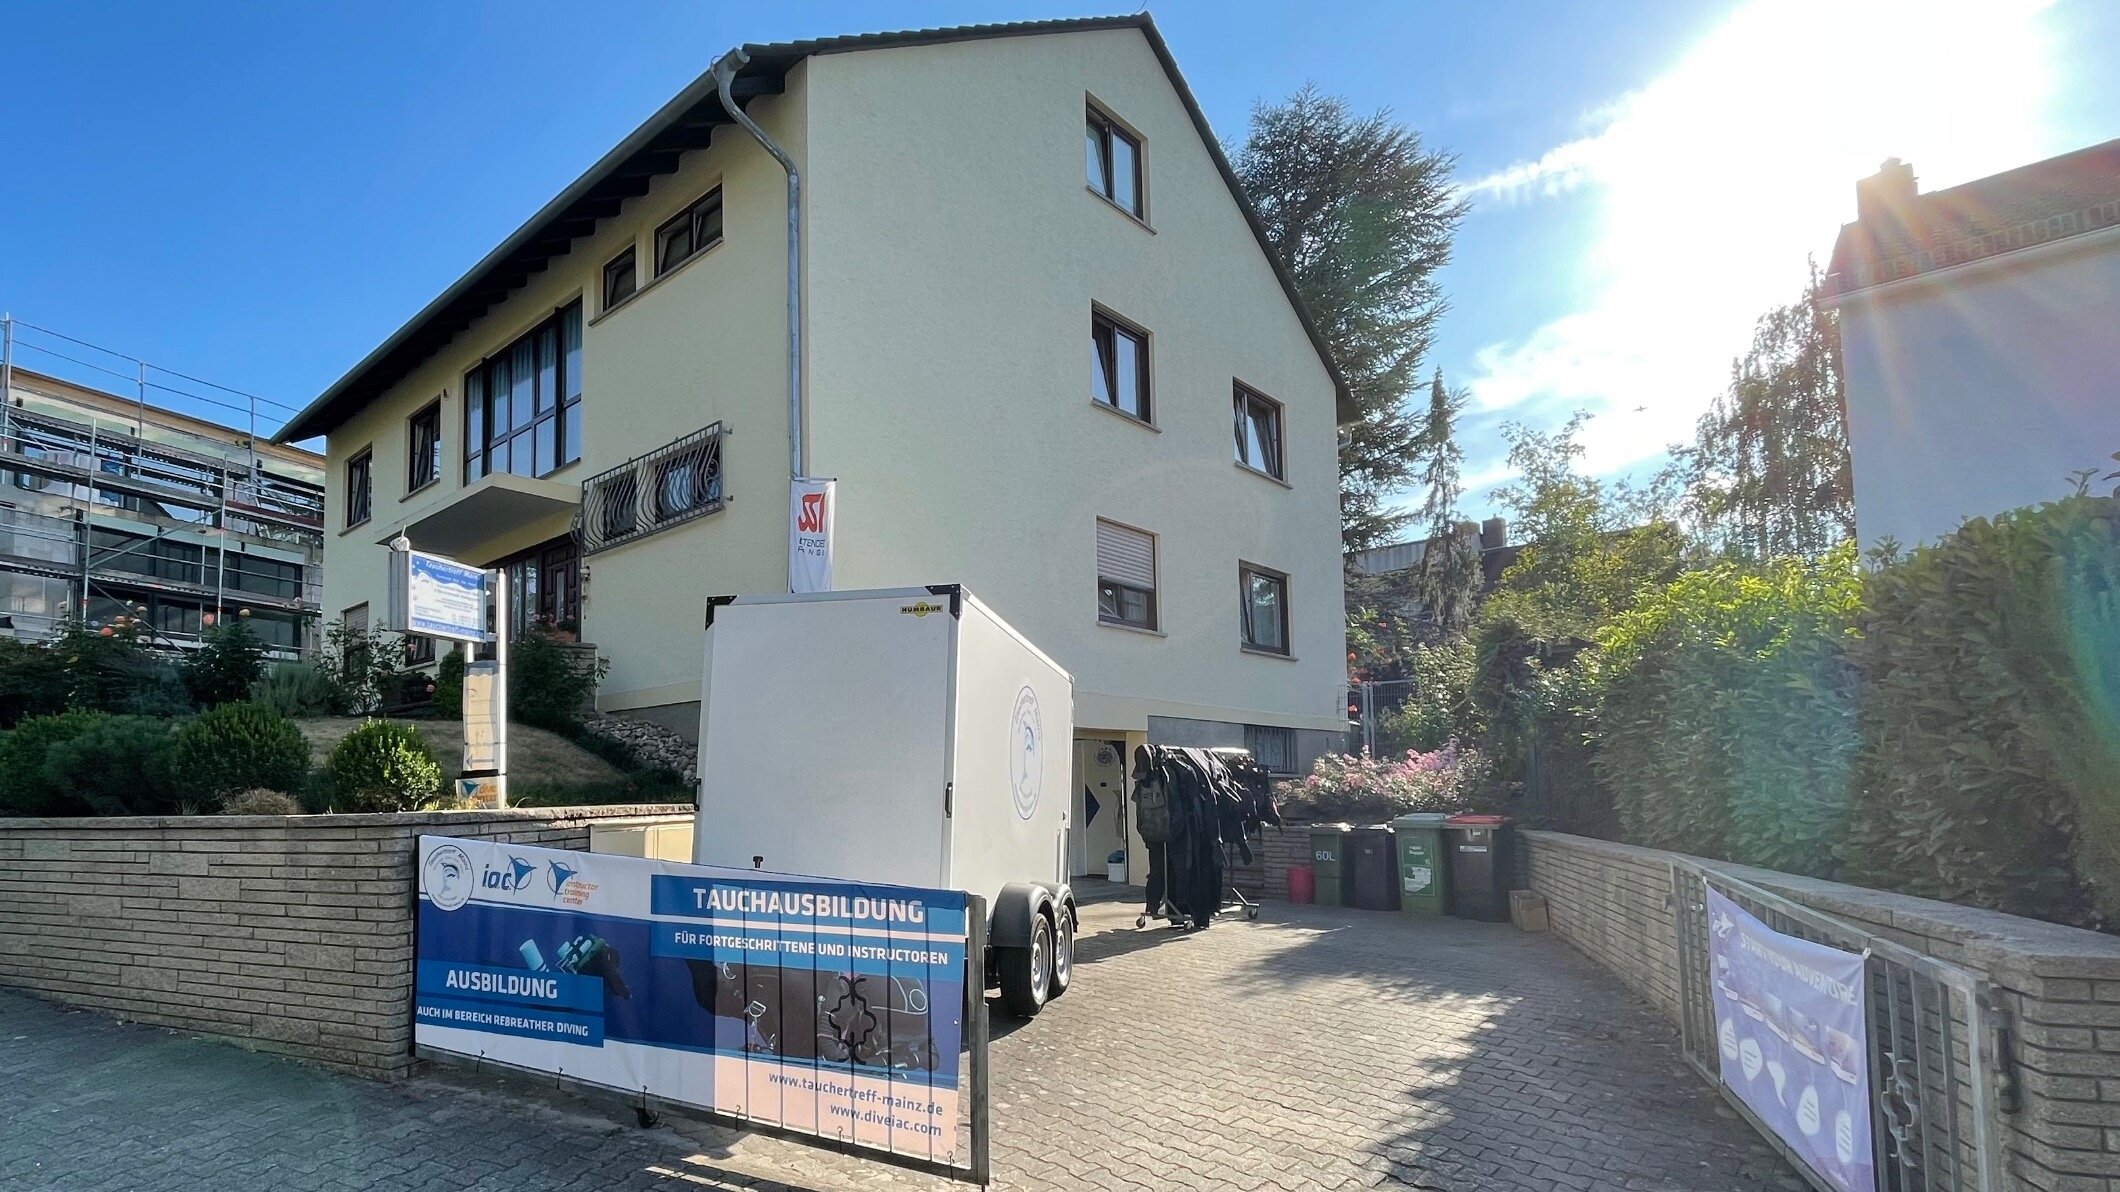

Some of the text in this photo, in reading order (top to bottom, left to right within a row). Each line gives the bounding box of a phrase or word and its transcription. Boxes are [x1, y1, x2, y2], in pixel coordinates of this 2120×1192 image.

[901, 605, 942, 613] HUMBAUR
[1315, 850, 1336, 862] 60L
[564, 888, 591, 901] training
[565, 880, 600, 891] instructor
[692, 888, 925, 924] TAUCHAUSBILDUNG
[674, 932, 949, 965] FÜR FORTGESCHRITTENE UND INSTRUCTOREN
[446, 969, 558, 999] AUSBILDUNG
[417, 1006, 589, 1037] AUCH IM BEREICH REBREATHER DIVING
[768, 1072, 943, 1116] www.tauchertreff-mainz.de
[830, 1104, 942, 1136] www.diveiac.com
